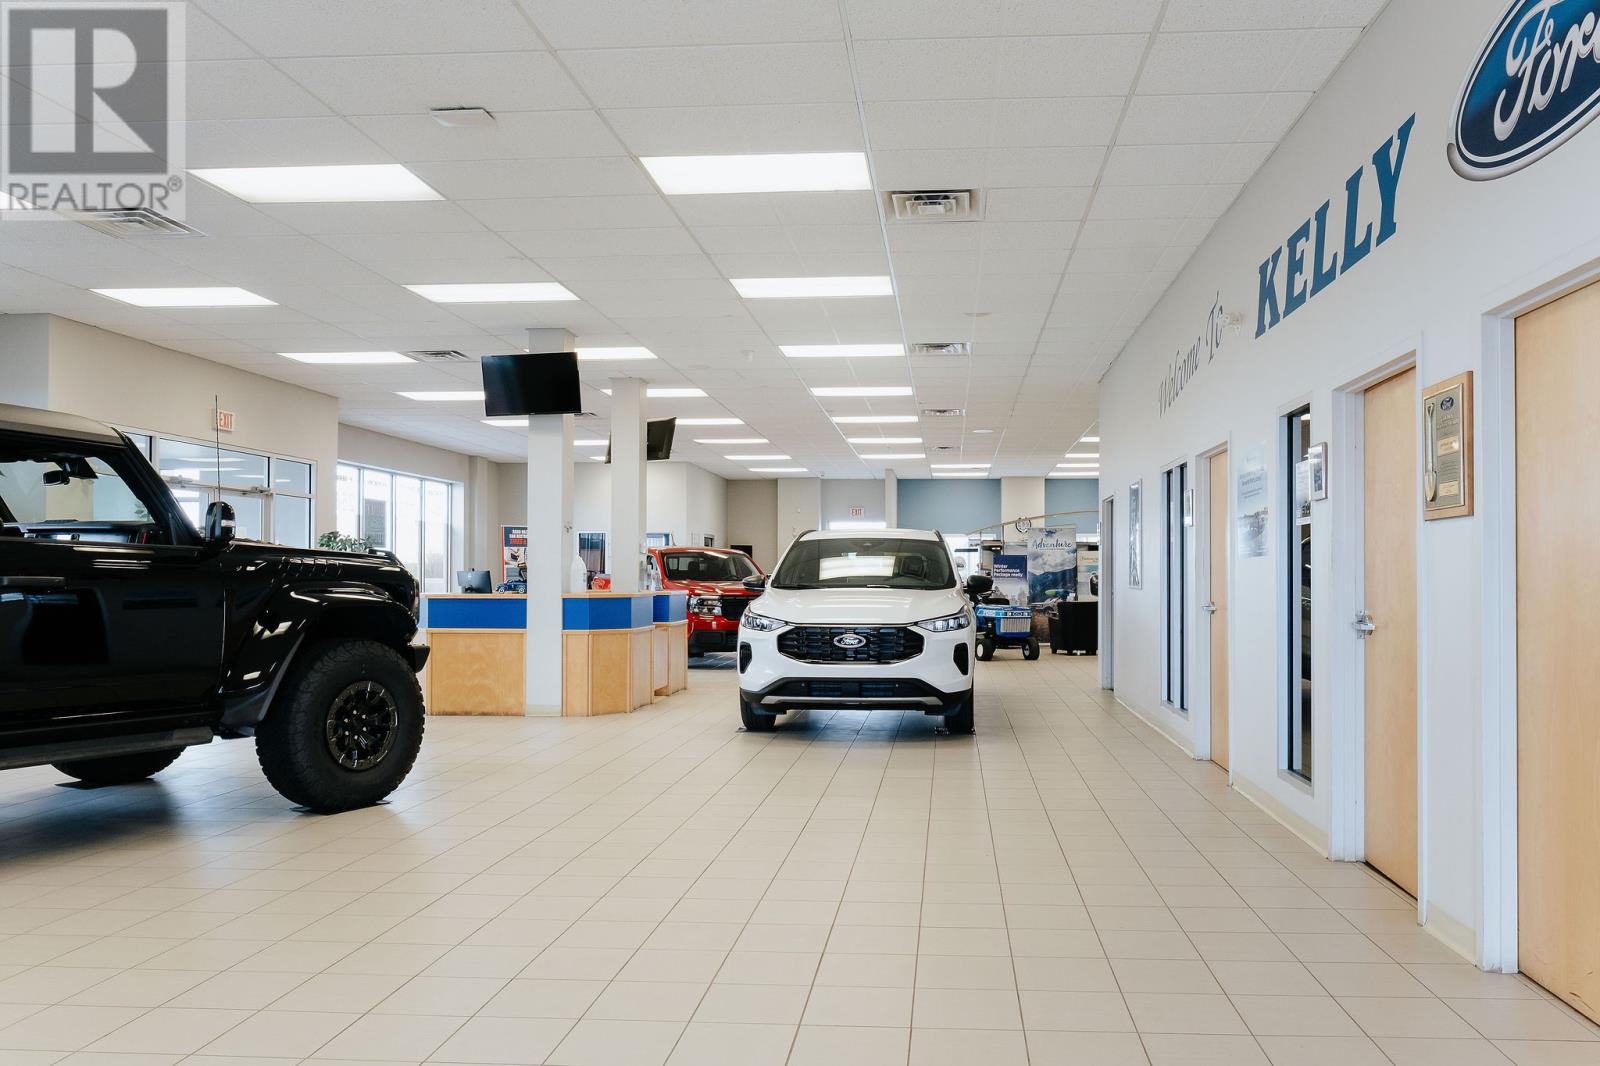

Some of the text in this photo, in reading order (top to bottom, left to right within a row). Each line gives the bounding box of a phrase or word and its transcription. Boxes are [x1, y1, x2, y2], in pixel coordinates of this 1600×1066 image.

[1493, 0, 1600, 141] For
[1255, 112, 1416, 340] KELLY
[1158, 335, 1201, 419] Welcome
[219, 411, 233, 429] EXIT
[852, 508, 862, 516] EXIT
